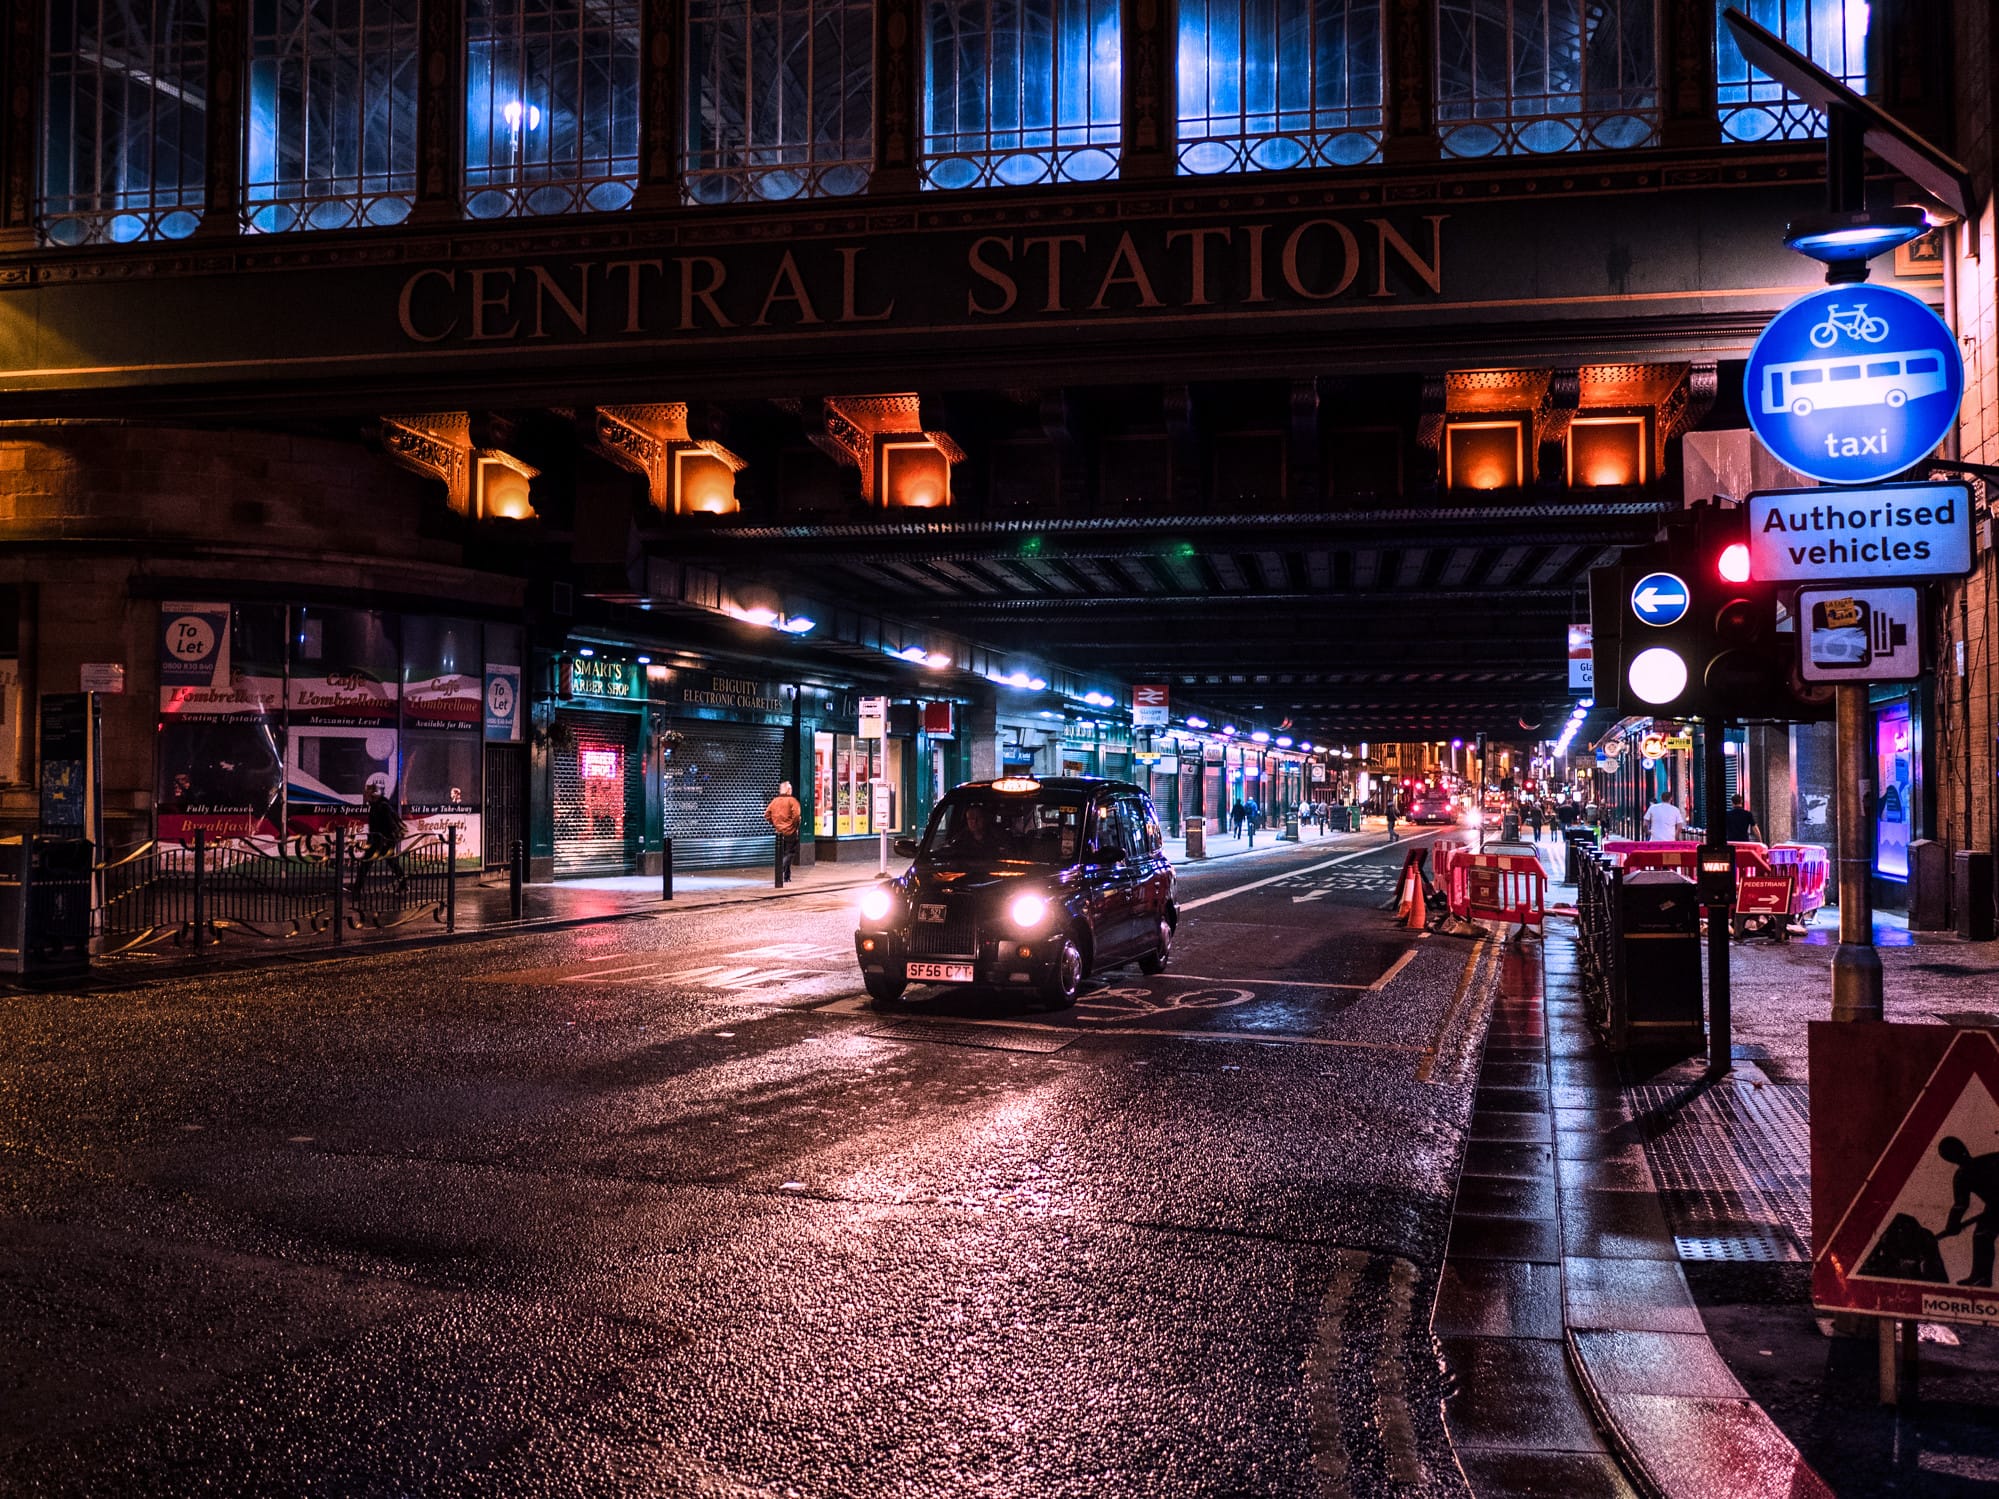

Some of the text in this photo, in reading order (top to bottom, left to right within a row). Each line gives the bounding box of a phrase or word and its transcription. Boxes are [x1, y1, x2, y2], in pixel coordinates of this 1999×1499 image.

[398, 212, 1454, 345] CENTRAL STATION
[1823, 427, 1889, 459] taxi
[1762, 498, 1956, 534] Authorised
[1788, 535, 1932, 566] vehicles
[178, 623, 198, 638] To
[176, 639, 204, 654] Let
[574, 658, 623, 680] SMART'S
[493, 682, 505, 696] To
[572, 680, 630, 697] ARBER SHOP
[711, 676, 760, 696] EBIGUITY
[493, 697, 508, 711] Let
[682, 687, 783, 712] ELECTRONIC CIGARETTES
[180, 713, 219, 724] Seating
[309, 715, 381, 727] Mezzanine Level
[415, 719, 472, 730] Available for Hire
[186, 803, 211, 815] Fully
[313, 805, 338, 814] Daily
[410, 804, 421, 814] Sit
[422, 804, 431, 814] In
[431, 806, 440, 814] or
[1702, 862, 1731, 872] WAIT
[910, 963, 942, 977] SF56
